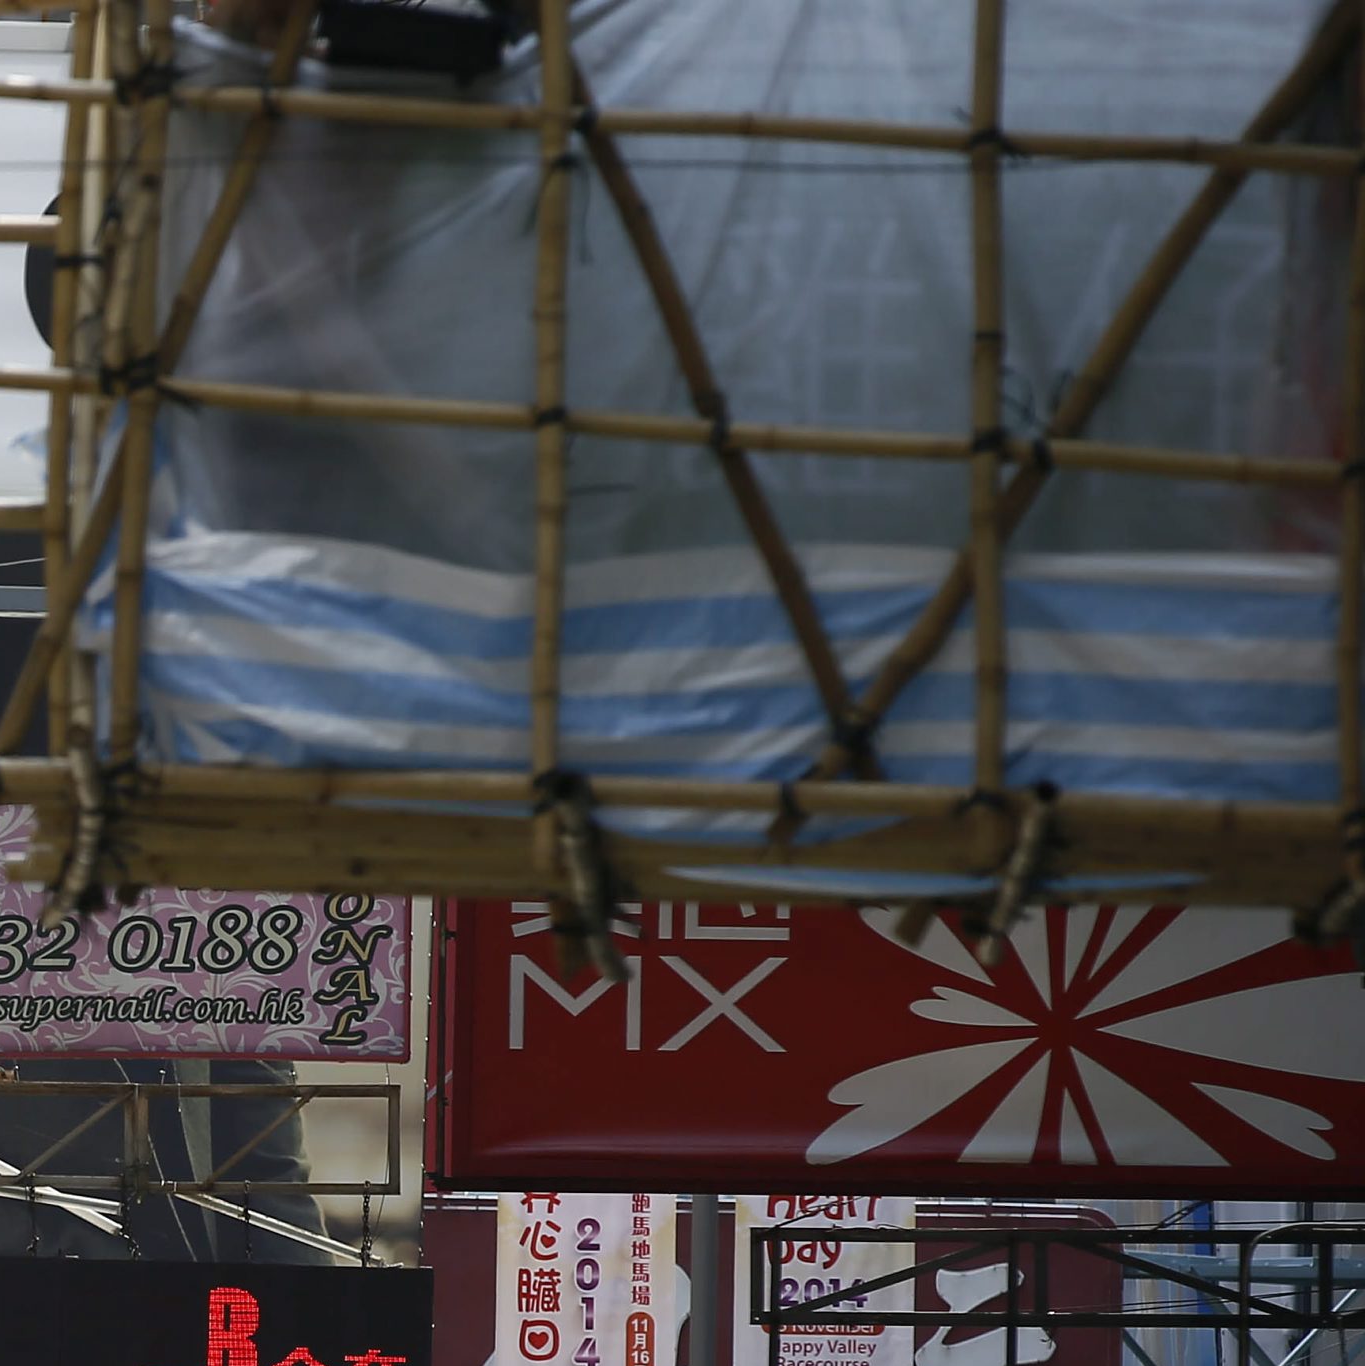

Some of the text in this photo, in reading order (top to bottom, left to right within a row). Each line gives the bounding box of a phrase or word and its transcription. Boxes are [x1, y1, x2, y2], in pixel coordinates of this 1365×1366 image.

[106, 904, 306, 976] 0188
[779, 1339, 877, 1357] appy Valley
